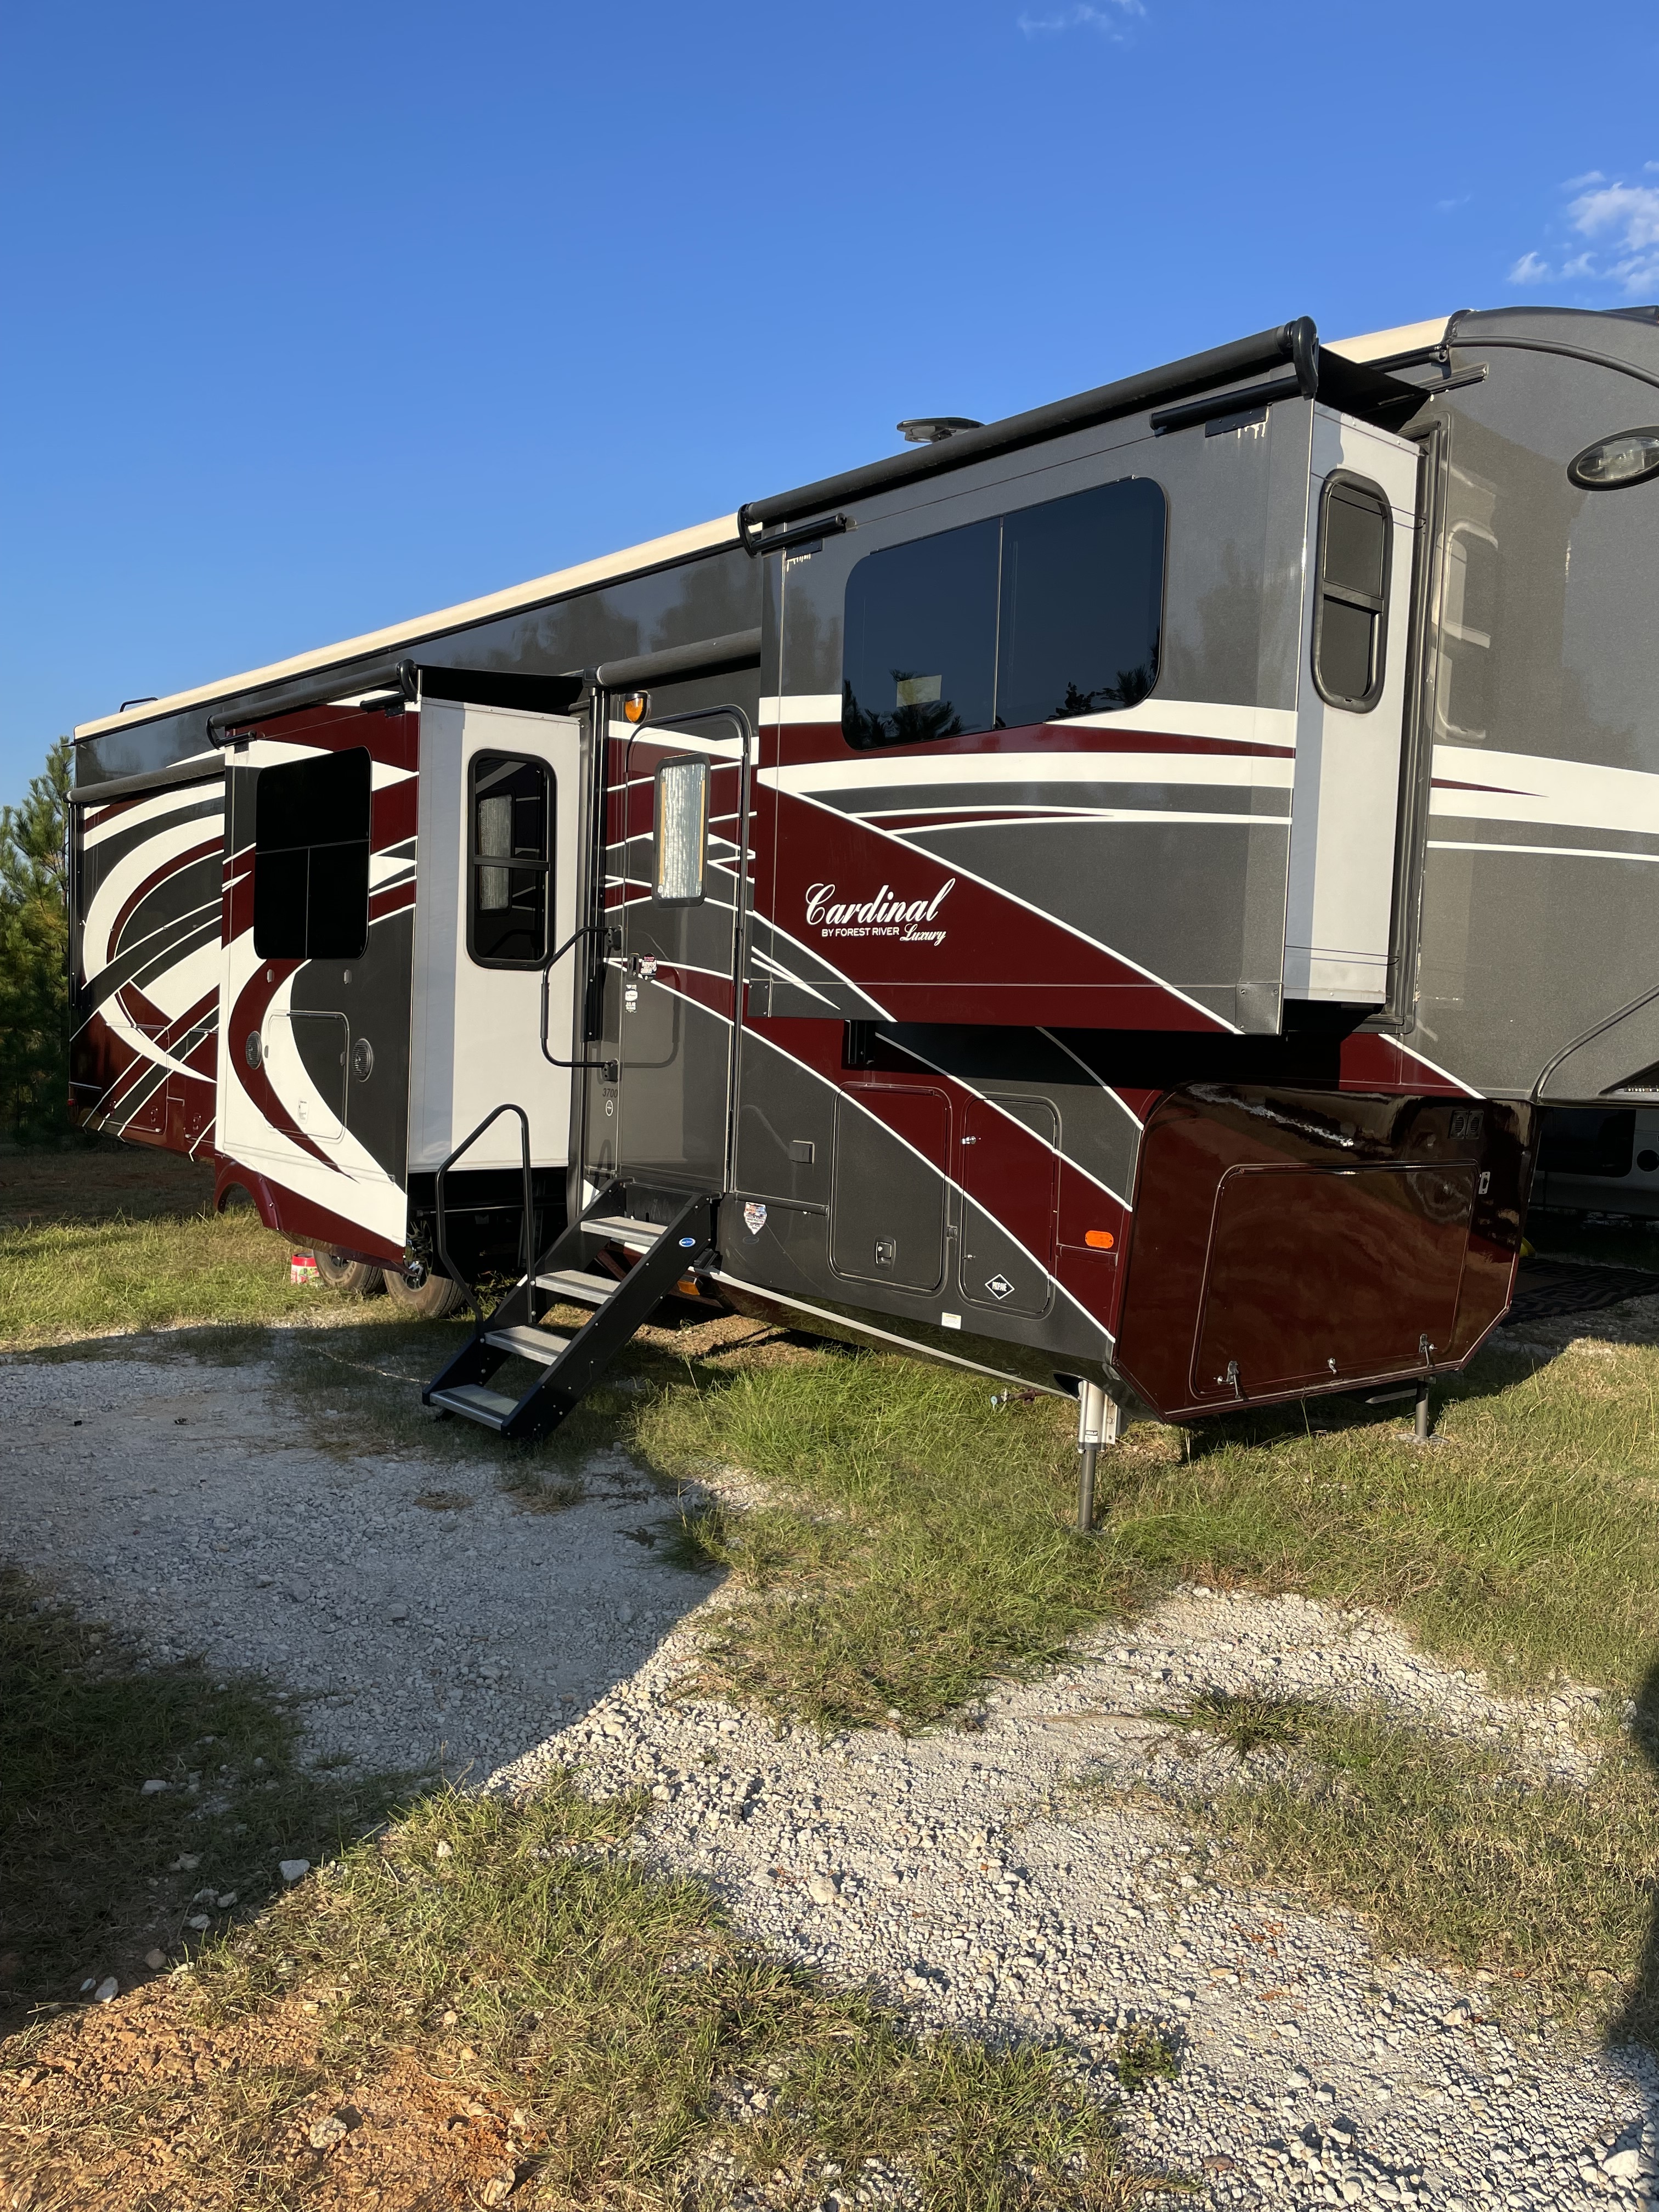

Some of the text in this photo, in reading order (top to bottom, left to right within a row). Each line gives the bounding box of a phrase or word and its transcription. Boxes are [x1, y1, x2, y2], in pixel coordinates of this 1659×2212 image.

[806, 878, 956, 925] Cardinal
[822, 927, 900, 937] BY FOREST RIVER
[899, 923, 946, 946] Luxury
[602, 1088, 618, 1098] 3700
[992, 1281, 1007, 1291] PROPANE
